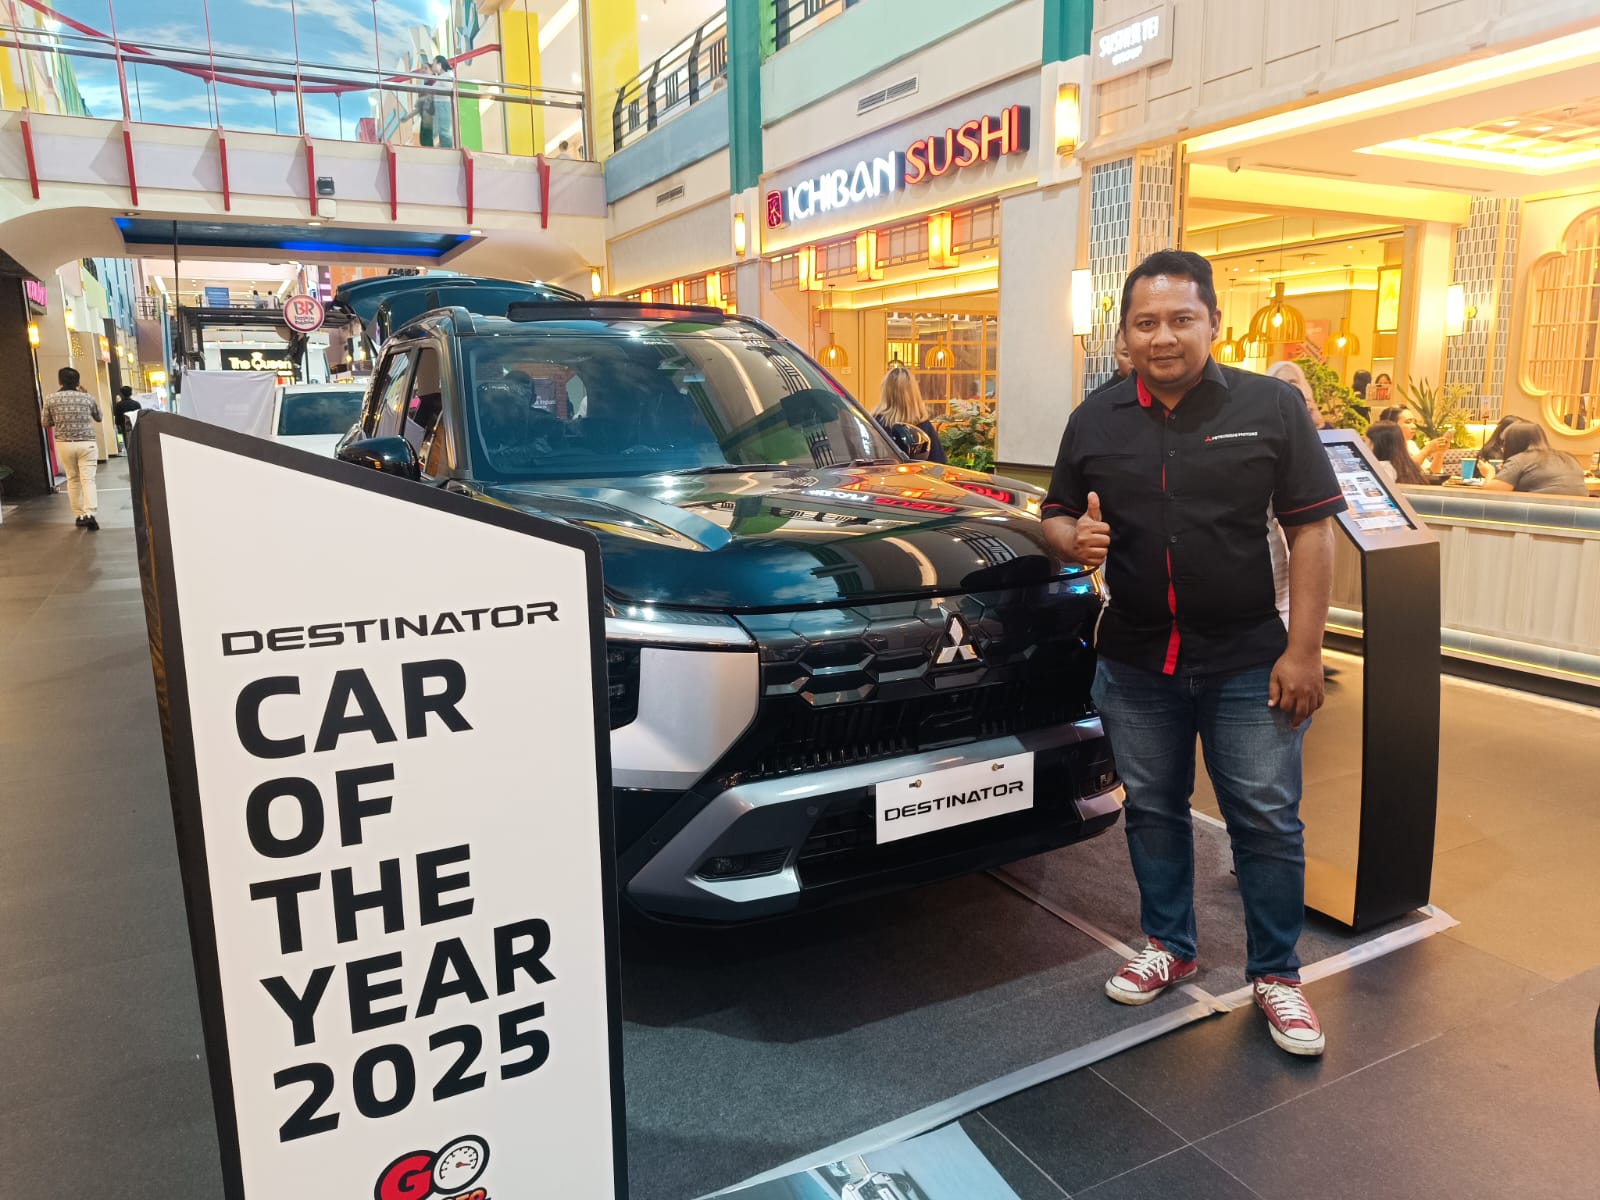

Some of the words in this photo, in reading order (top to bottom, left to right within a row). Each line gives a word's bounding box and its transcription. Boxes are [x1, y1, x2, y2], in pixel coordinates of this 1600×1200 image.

[787, 150, 896, 222] ICHIBAN
[904, 104, 1021, 185] SUSHI
[221, 601, 560, 656] DESTINATOR
[235, 658, 474, 759] CAR
[246, 762, 395, 858] OF
[884, 780, 1024, 821] DESTINATOR
[249, 843, 474, 955] THE
[259, 918, 557, 1047] YEAR
[273, 1001, 550, 1143] 2025
